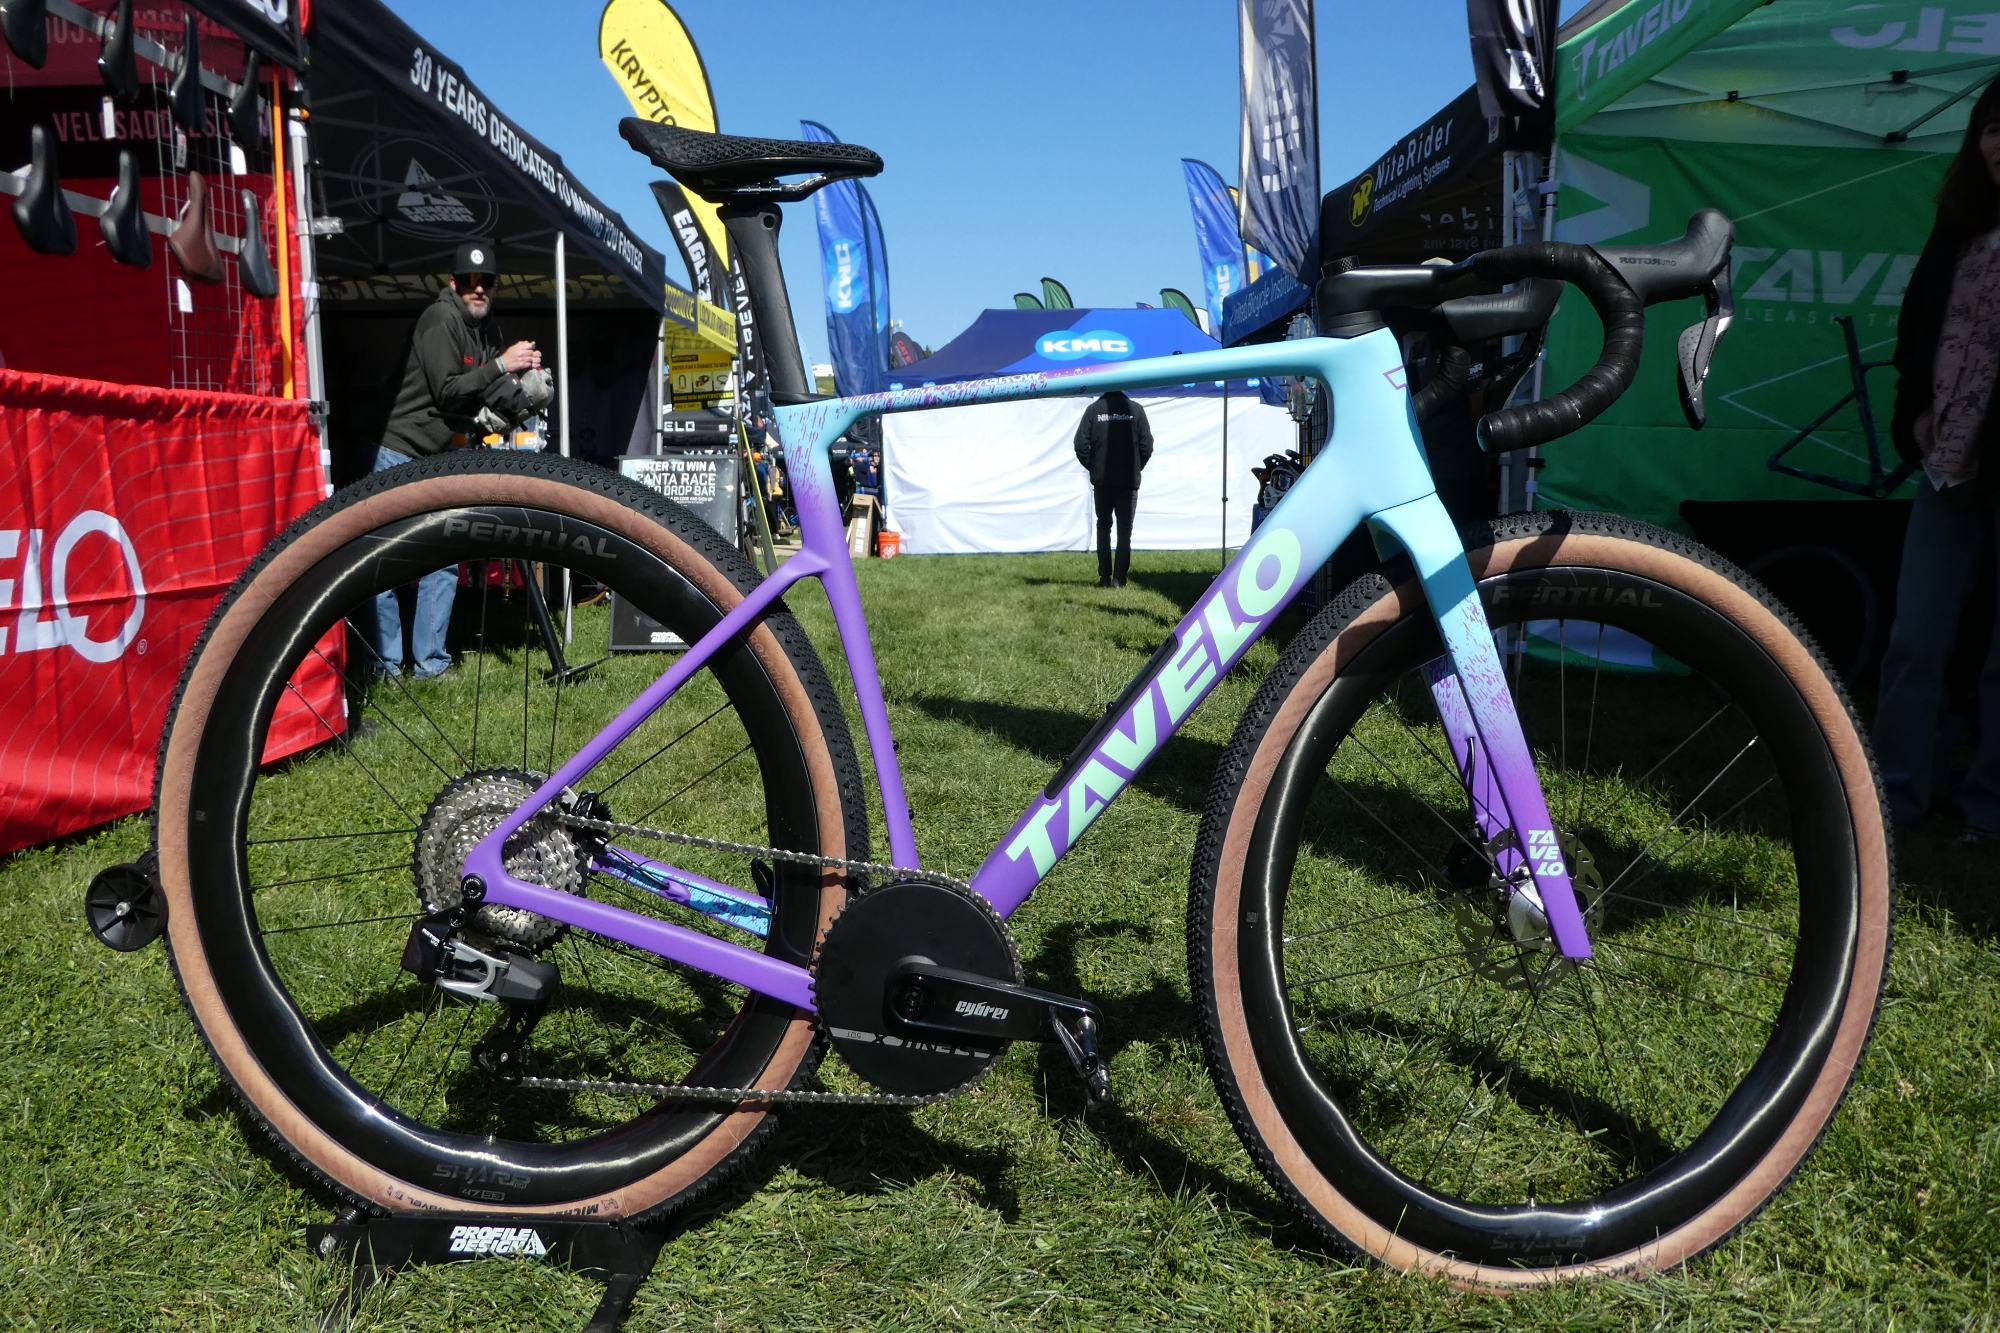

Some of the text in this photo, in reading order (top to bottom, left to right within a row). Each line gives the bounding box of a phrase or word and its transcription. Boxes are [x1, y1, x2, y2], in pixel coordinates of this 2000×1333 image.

[410, 47, 643, 275] 30 YEARS DEDICATED TO MAKING YOU FASTER
[1374, 118, 1453, 192] NiteRider
[1374, 155, 1451, 213] Technical Lighting Systems
[835, 243, 852, 308] KMC
[1248, 284, 1271, 317] Bicycle
[1043, 339, 1128, 353] KMC
[1097, 413, 1134, 422] NiteRider
[635, 461, 717, 471] ENTER TO WIN A
[681, 473, 716, 486] RACE
[664, 485, 691, 496] DROP
[693, 485, 716, 496] BAR
[443, 517, 618, 560] PERTUAL
[1491, 585, 1663, 609] PERTUAL
[1005, 528, 1302, 880] TAVELO
[1528, 829, 1555, 844] TA
[1529, 845, 1560, 860] VE
[1535, 861, 1565, 876] LO
[432, 1163, 531, 1187] SHARP
[450, 1226, 533, 1240] PROFILE
[449, 1239, 527, 1253] DESIGN
